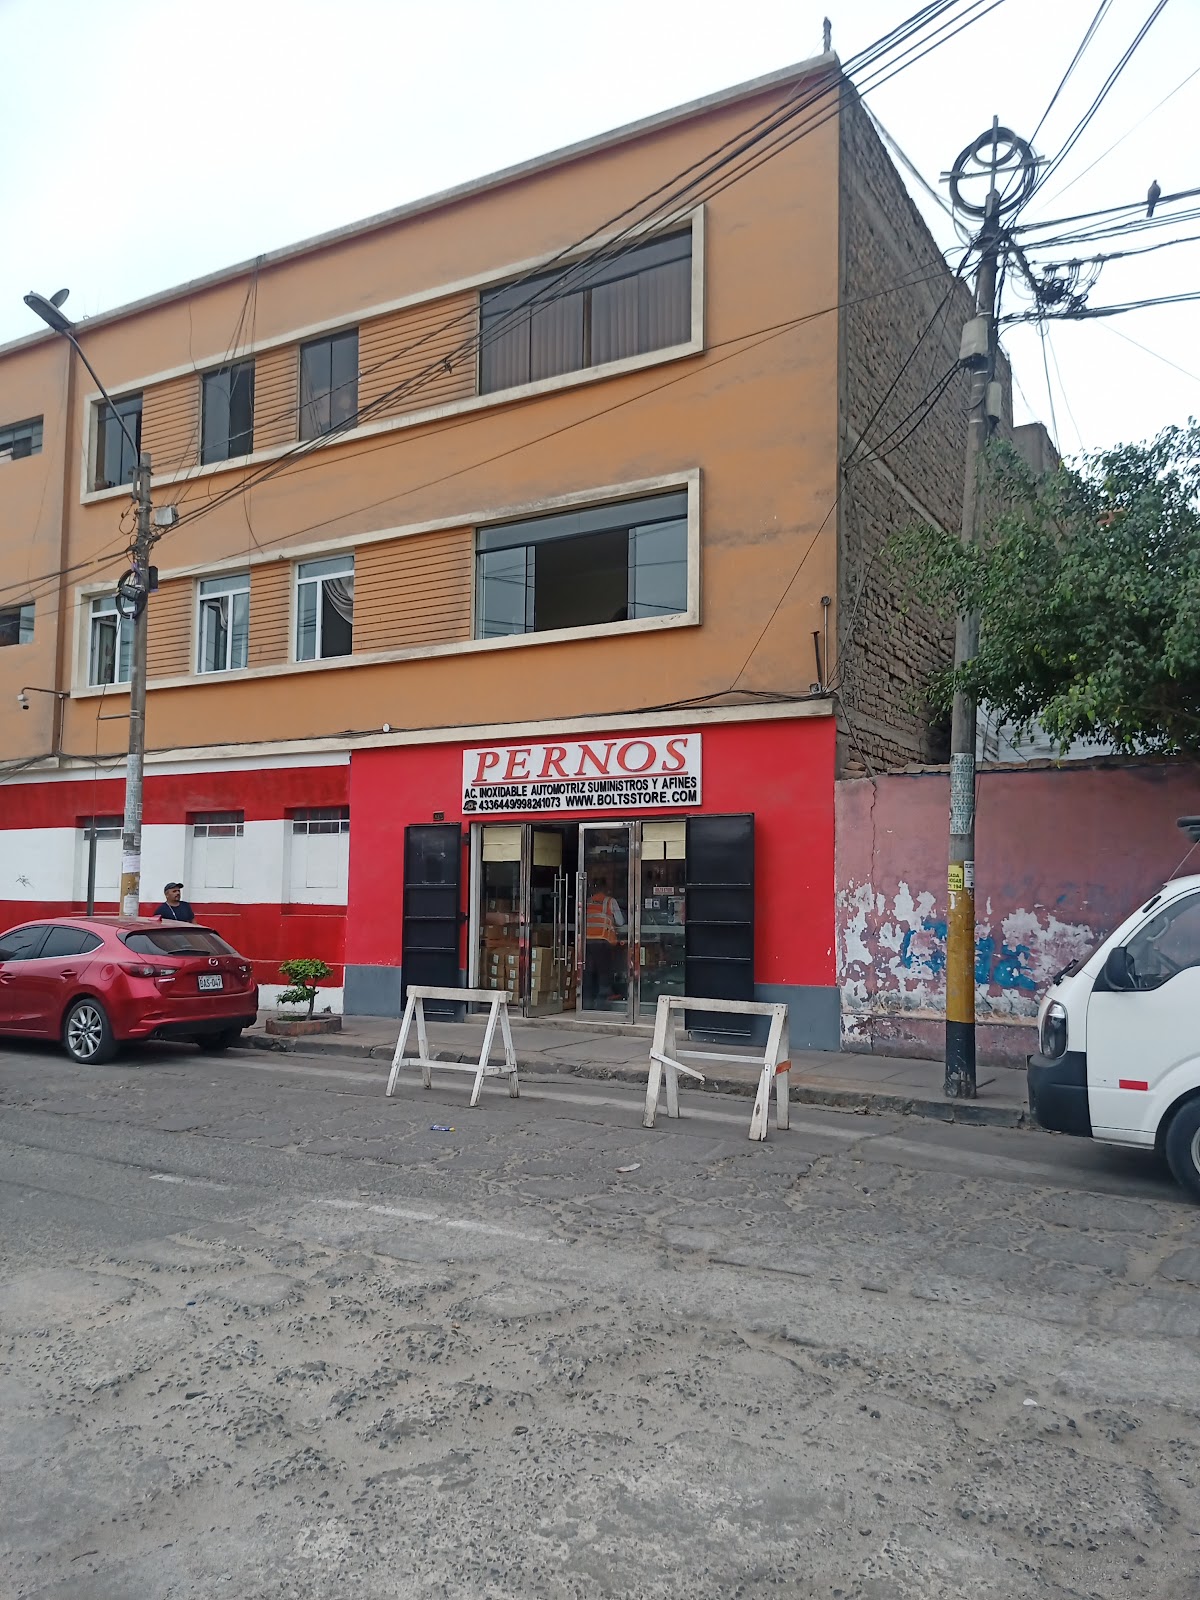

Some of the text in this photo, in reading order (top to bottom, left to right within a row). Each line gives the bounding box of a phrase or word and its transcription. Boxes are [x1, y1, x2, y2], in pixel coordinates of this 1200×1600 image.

[472, 738, 688, 782] PERNOS
[531, 782, 586, 796] AUTOMOTRIZ
[652, 778, 659, 789] Y
[662, 776, 697, 789] AFINES
[478, 797, 561, 811] 4336449/998241073
